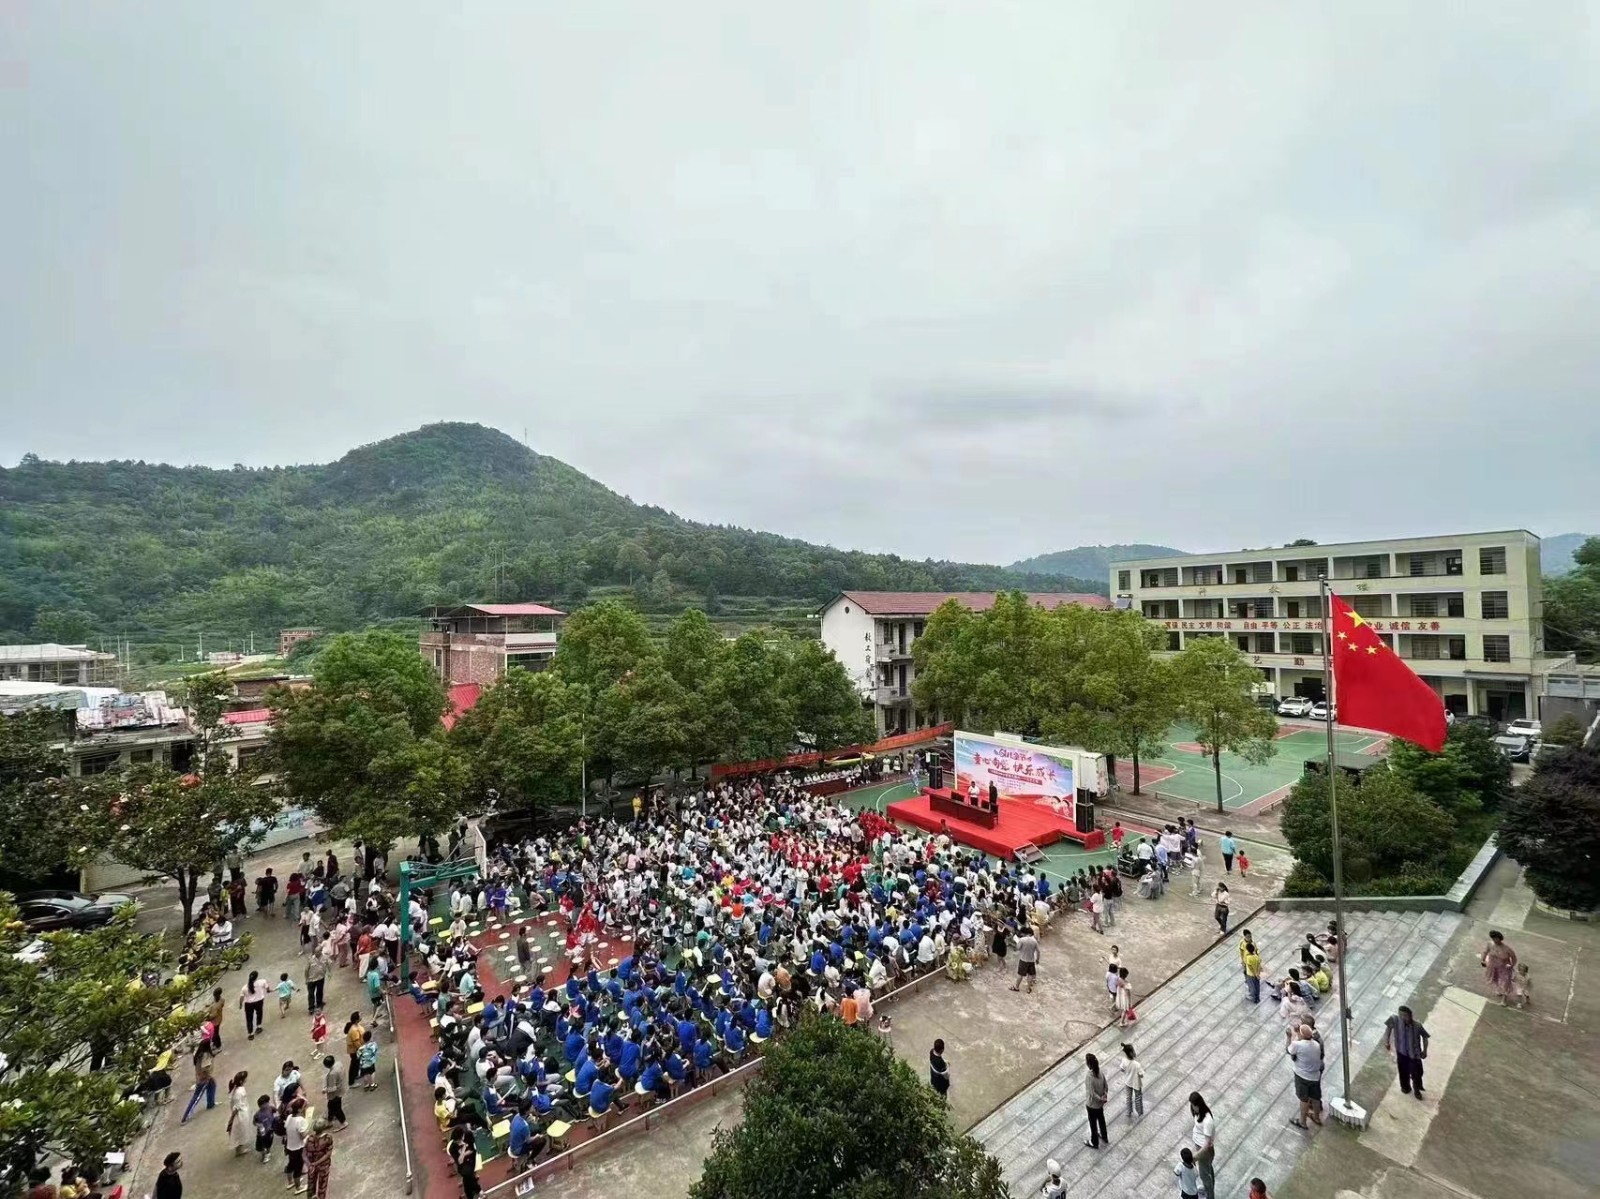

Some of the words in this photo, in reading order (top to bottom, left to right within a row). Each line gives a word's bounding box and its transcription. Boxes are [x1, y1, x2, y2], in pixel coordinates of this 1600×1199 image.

[1181, 621, 1195, 630] 民主
[1198, 621, 1213, 630] 文明
[1216, 621, 1232, 629] 和谐
[1243, 621, 1258, 630] 自由
[1261, 621, 1278, 630] 平等
[1282, 621, 1301, 630] 公正
[1389, 621, 1411, 631] 诚信
[1417, 621, 1441, 631] 友善
[1012, 761, 1057, 782] 快乐成长
